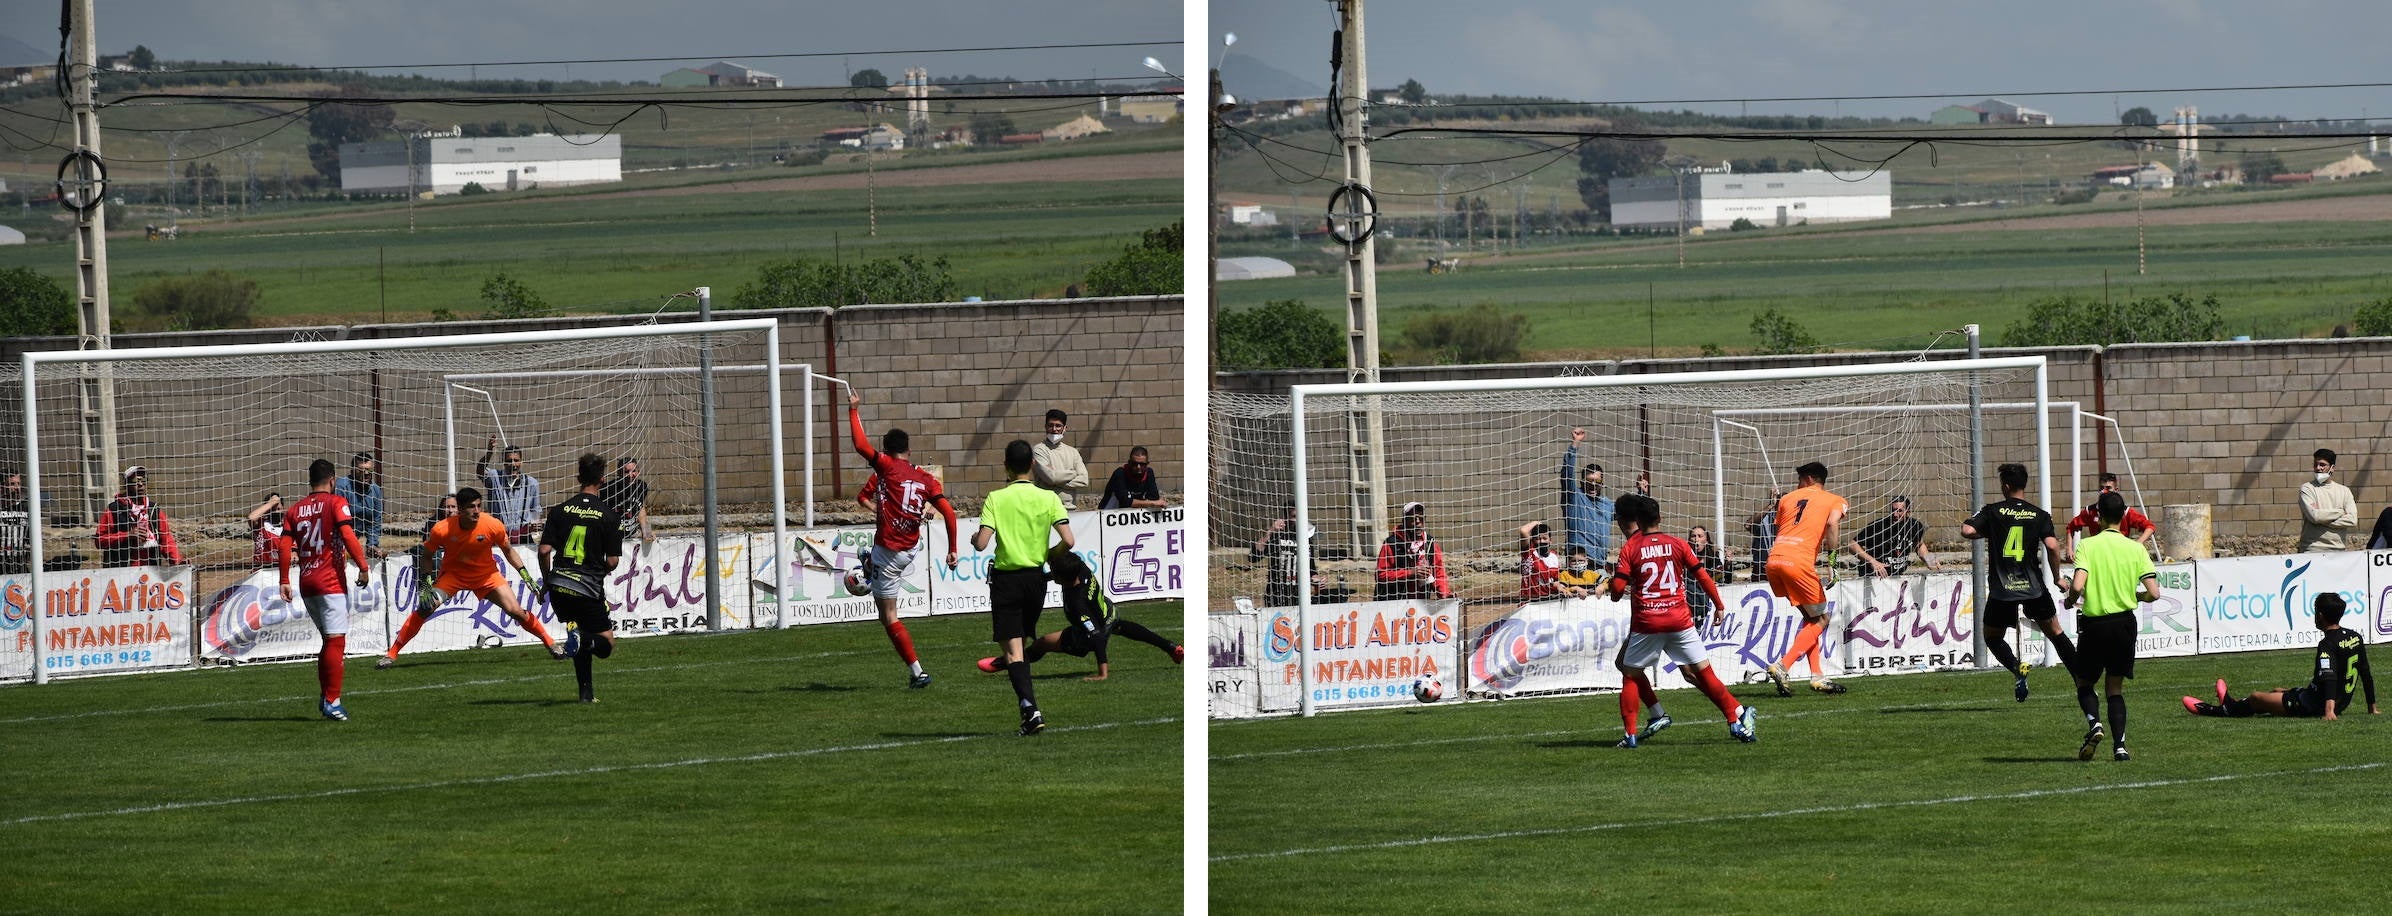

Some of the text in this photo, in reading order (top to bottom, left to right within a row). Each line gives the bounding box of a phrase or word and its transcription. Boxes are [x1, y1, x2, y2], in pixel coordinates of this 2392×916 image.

[900, 480, 926, 515] 15
[1793, 498, 1809, 525] 1
[297, 518, 324, 557] 24
[563, 525, 588, 565] 4
[1640, 543, 1672, 560] JUANLU
[2002, 526, 2025, 562] 4
[98, 574, 186, 615] Arias
[1640, 560, 1678, 599] 24
[791, 602, 842, 619] TOSTADO
[844, 597, 906, 619] RODRIZ
[258, 630, 312, 646] Pinturas
[1365, 607, 1452, 648] Arias
[2203, 628, 2280, 649] FISIOTERAPIA
[2285, 626, 2292, 644] &
[46, 650, 153, 669] 615 668 942
[1525, 663, 1580, 678] Pinturas
[2344, 654, 2358, 694] 5
[1313, 687, 1341, 701] 615
[1347, 685, 1381, 699] 668
